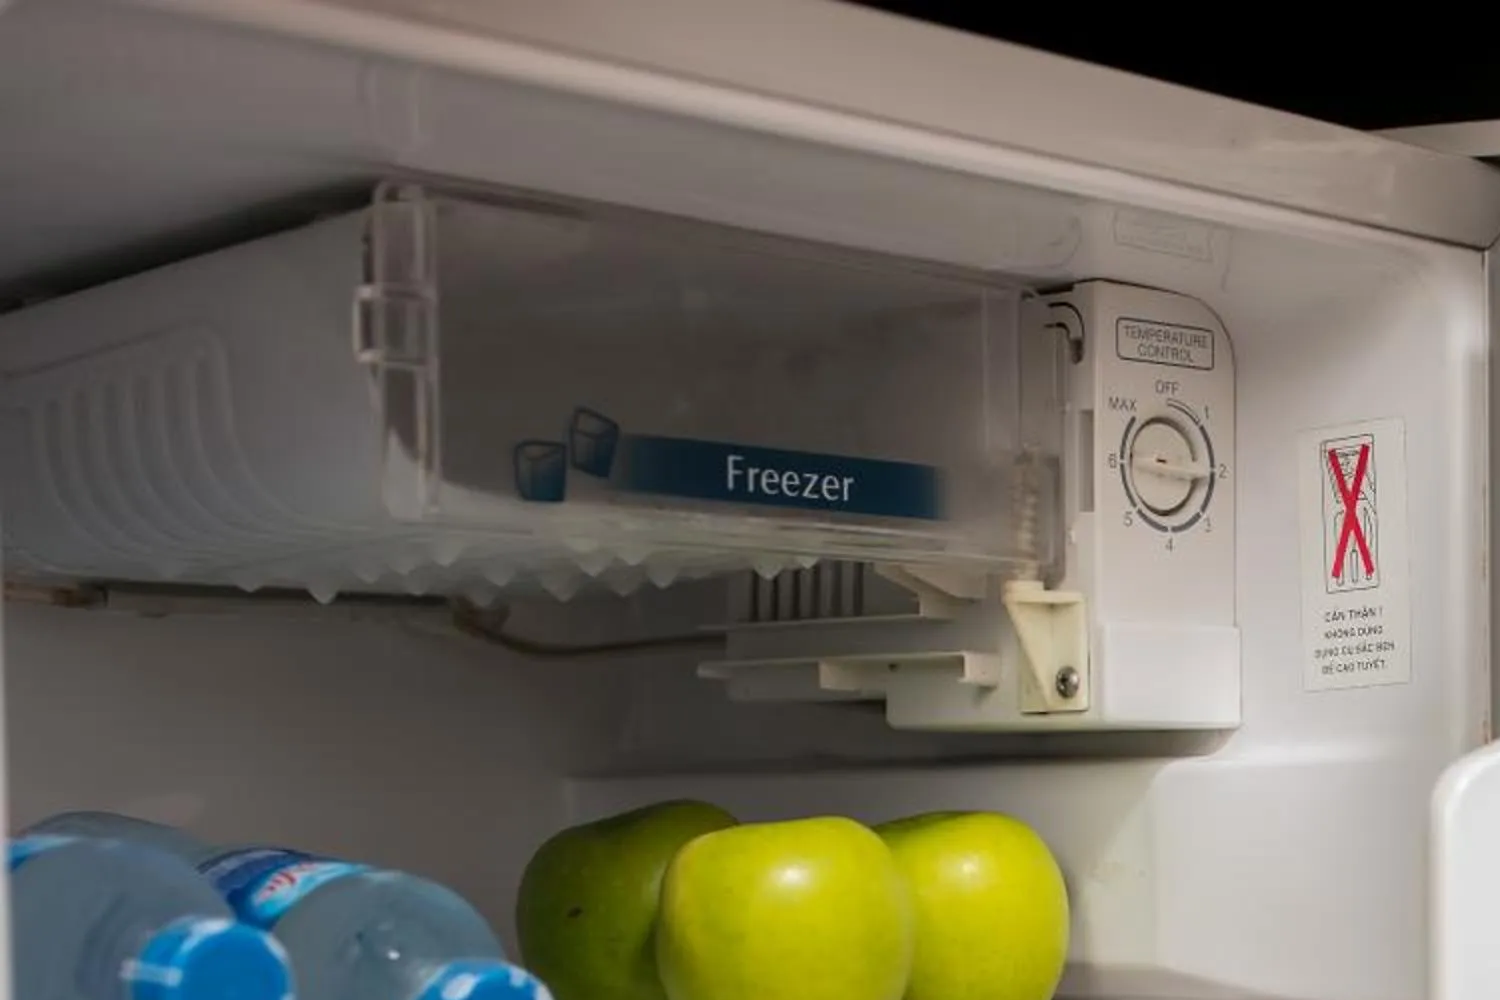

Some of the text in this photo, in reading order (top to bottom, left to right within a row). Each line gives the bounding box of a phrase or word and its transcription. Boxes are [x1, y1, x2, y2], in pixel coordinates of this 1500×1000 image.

[1123, 325, 1209, 349] TEMPERATURE
[1136, 343, 1194, 363] CONTROL
[1155, 380, 1179, 395] OFF
[1109, 397, 1138, 412] MAX
[726, 454, 855, 502] Freezer
[1218, 463, 1228, 479] 2
[1123, 511, 1133, 527] 5
[1165, 538, 1174, 552] 4
